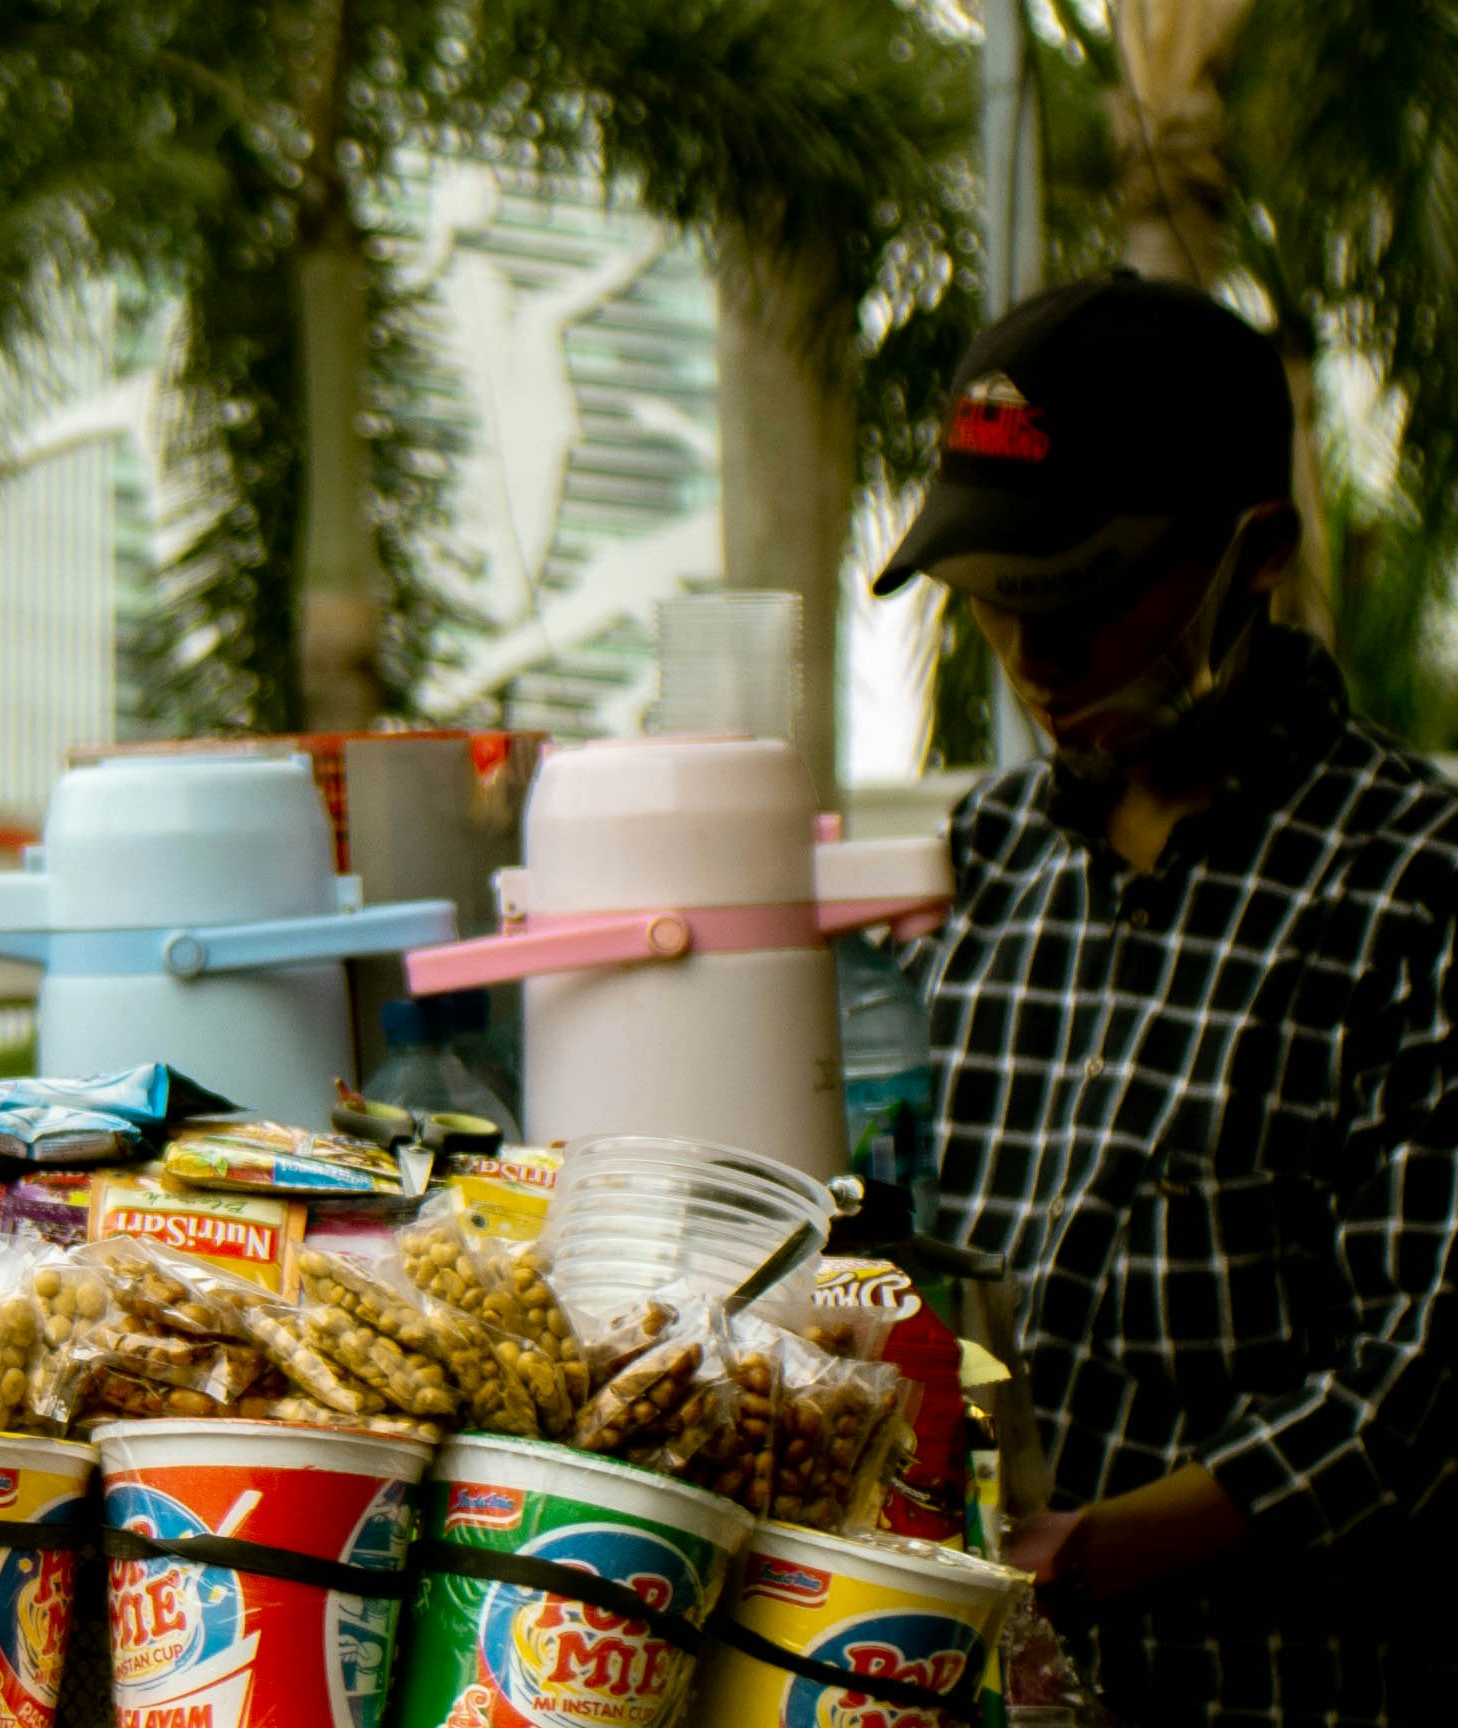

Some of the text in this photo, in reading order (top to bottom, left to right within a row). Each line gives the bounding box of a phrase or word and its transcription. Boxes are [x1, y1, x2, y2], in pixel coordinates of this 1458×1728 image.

[152, 1644, 184, 1664] CUP
[547, 1630, 677, 1698] MIE
[531, 1696, 556, 1712] MI
[562, 1698, 624, 1719] INSTAN
